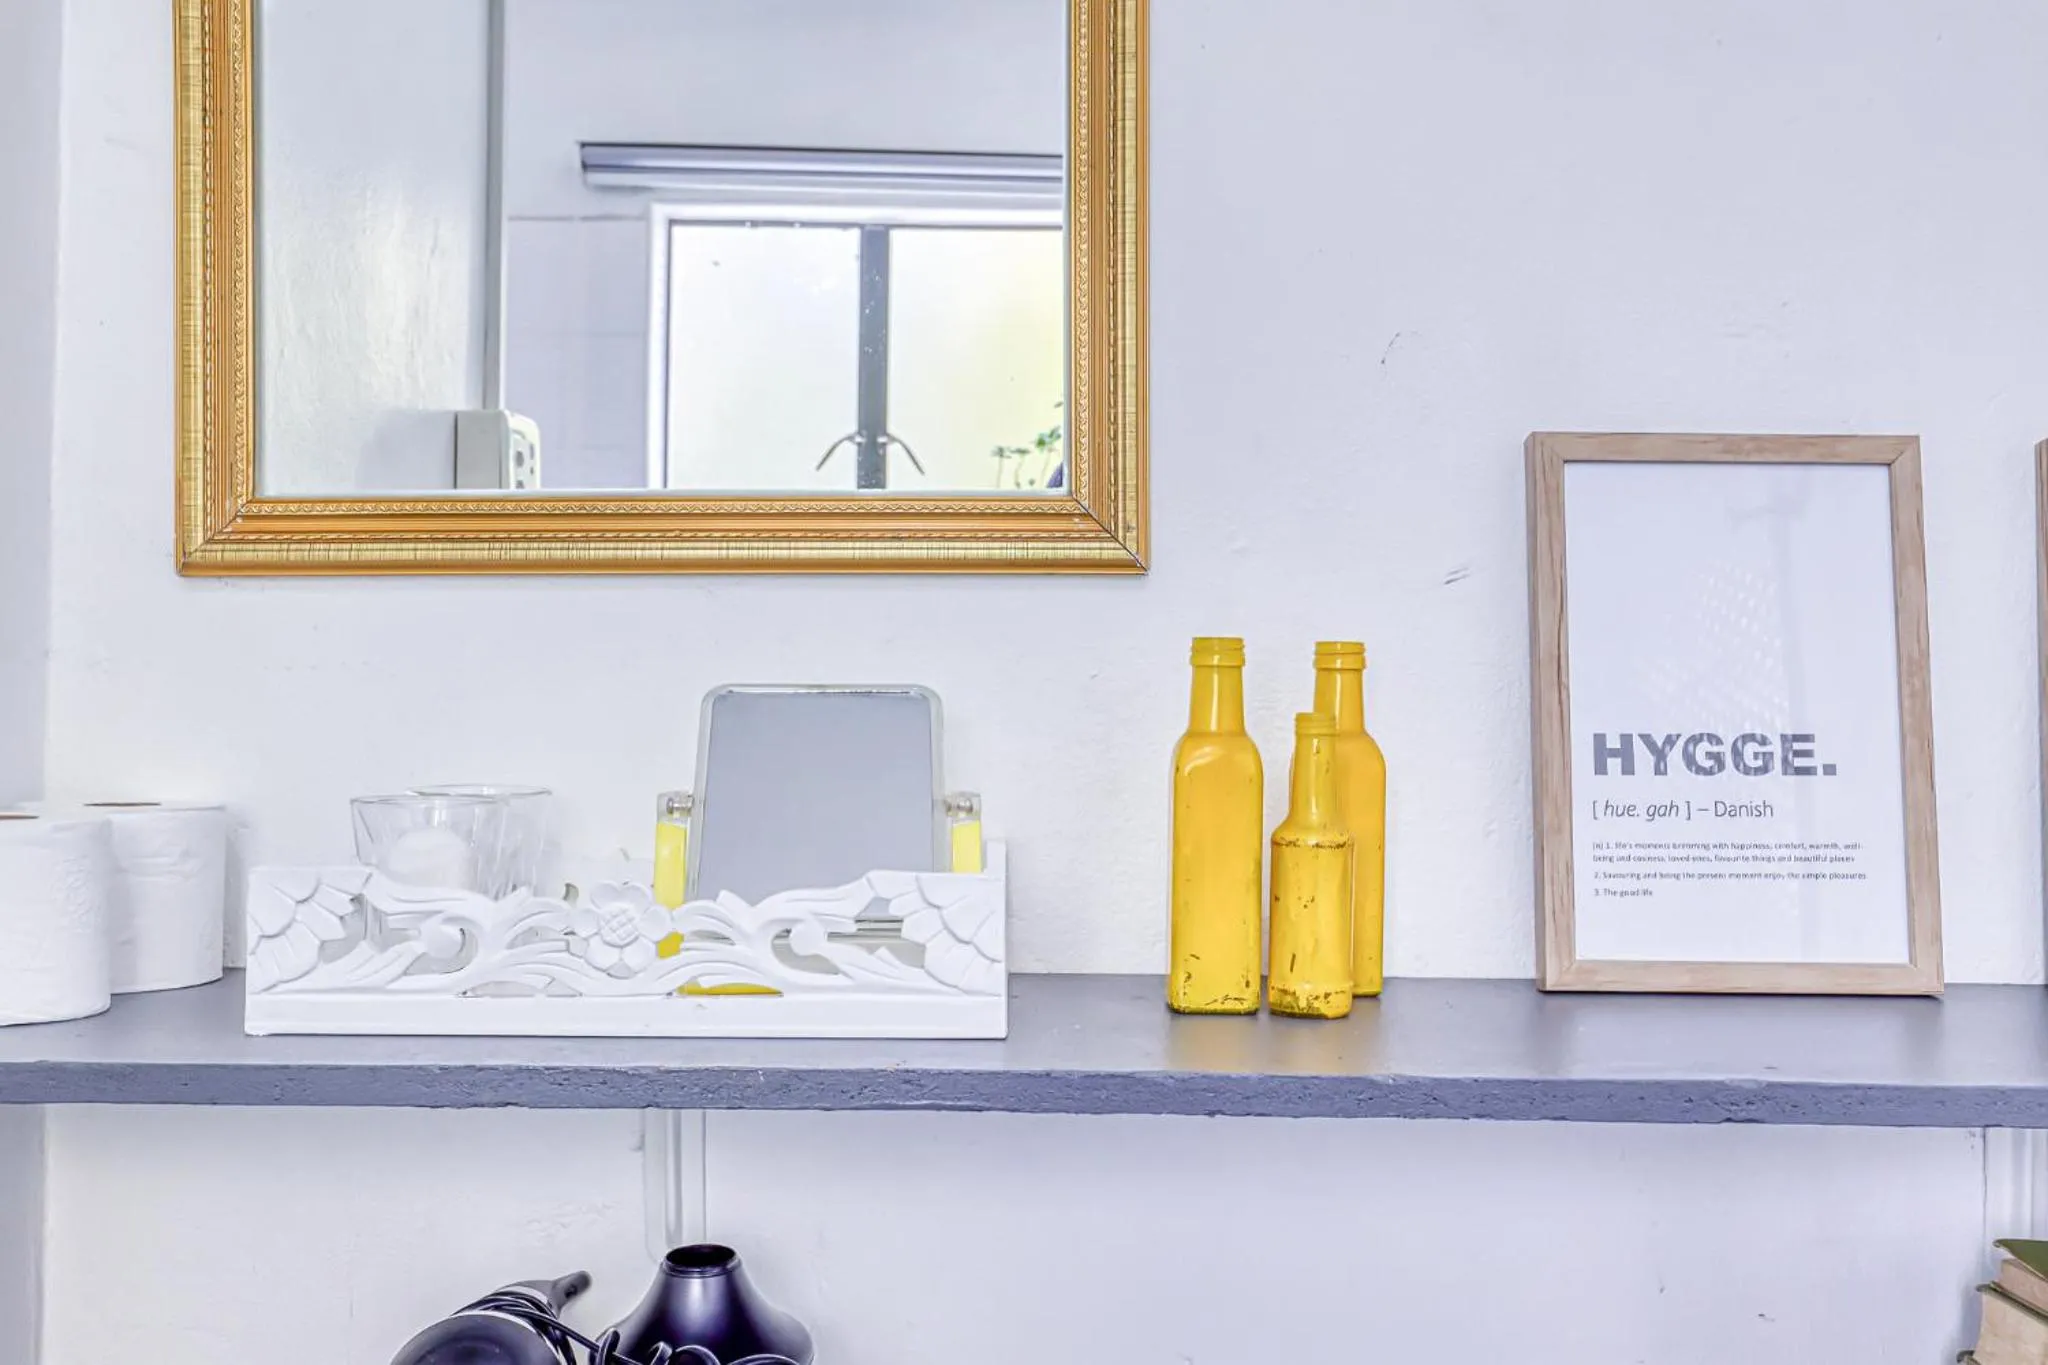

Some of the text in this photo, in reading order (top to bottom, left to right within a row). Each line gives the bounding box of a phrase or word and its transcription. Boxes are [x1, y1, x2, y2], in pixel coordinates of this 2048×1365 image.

[1593, 732, 1837, 776] HYGGE.
[1603, 799, 1640, 818] hue.
[1646, 799, 1679, 822] gah
[1714, 799, 1774, 818] Danish
[1712, 842, 1729, 850] with
[1592, 854, 1615, 864] being
[1616, 854, 1631, 862] and
[1667, 854, 1690, 862] loved
[1714, 854, 1750, 862] favourite
[1751, 854, 1776, 864] things
[1777, 854, 1792, 862] and
[1793, 854, 1828, 862] beautiful
[1603, 871, 1641, 881] Savouring
[1642, 871, 1657, 879] and
[1683, 871, 1695, 879] the
[1697, 872, 1727, 881] present
[1728, 872, 1762, 880] moment
[1764, 872, 1786, 882] enjoy
[1787, 872, 1800, 880] the
[1801, 872, 1827, 882] simple
[1603, 888, 1618, 897] The
[1619, 888, 1640, 898] good
[1642, 888, 1653, 897] life
